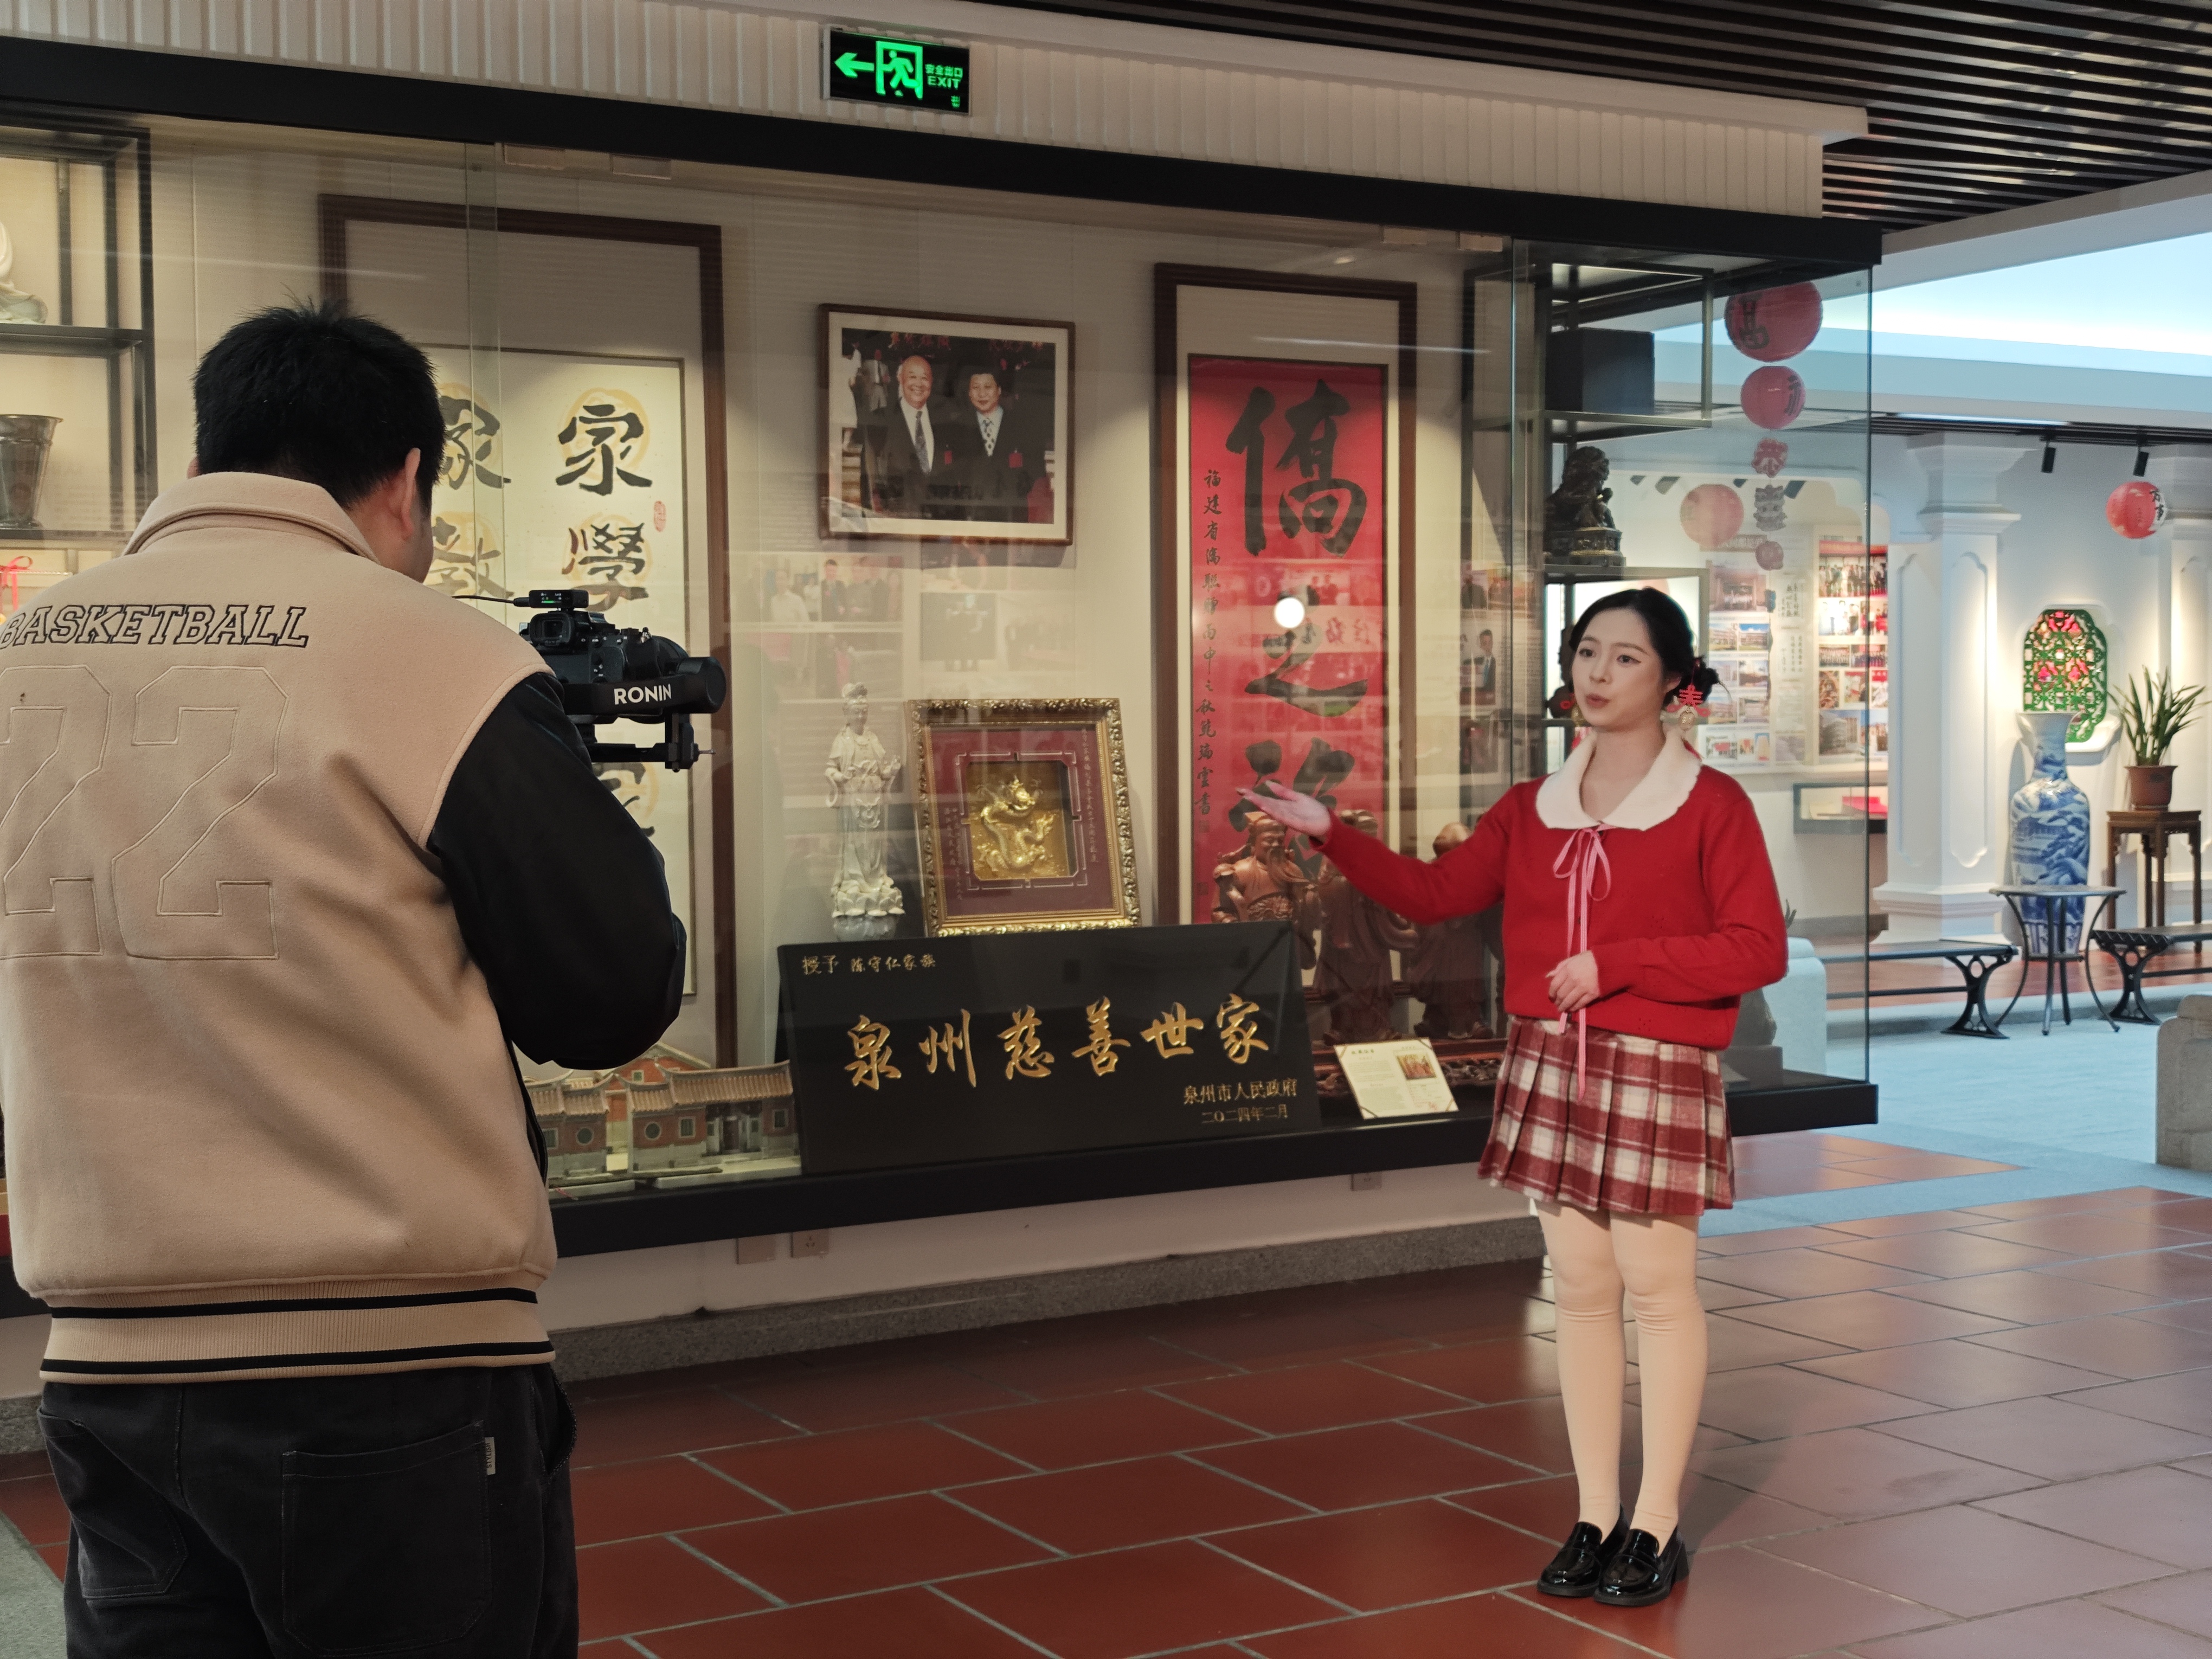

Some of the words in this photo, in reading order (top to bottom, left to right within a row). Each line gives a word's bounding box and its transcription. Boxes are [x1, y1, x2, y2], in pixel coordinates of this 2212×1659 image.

[925, 64, 963, 78] 安全出口
[927, 76, 961, 89] EXIT
[0, 604, 310, 649] BASKETBALL
[614, 683, 672, 705] RONIN
[802, 954, 839, 975] 授予
[843, 992, 1270, 1091] 泉州慈善世家
[1183, 1077, 1298, 1105] 泉州市人民政府
